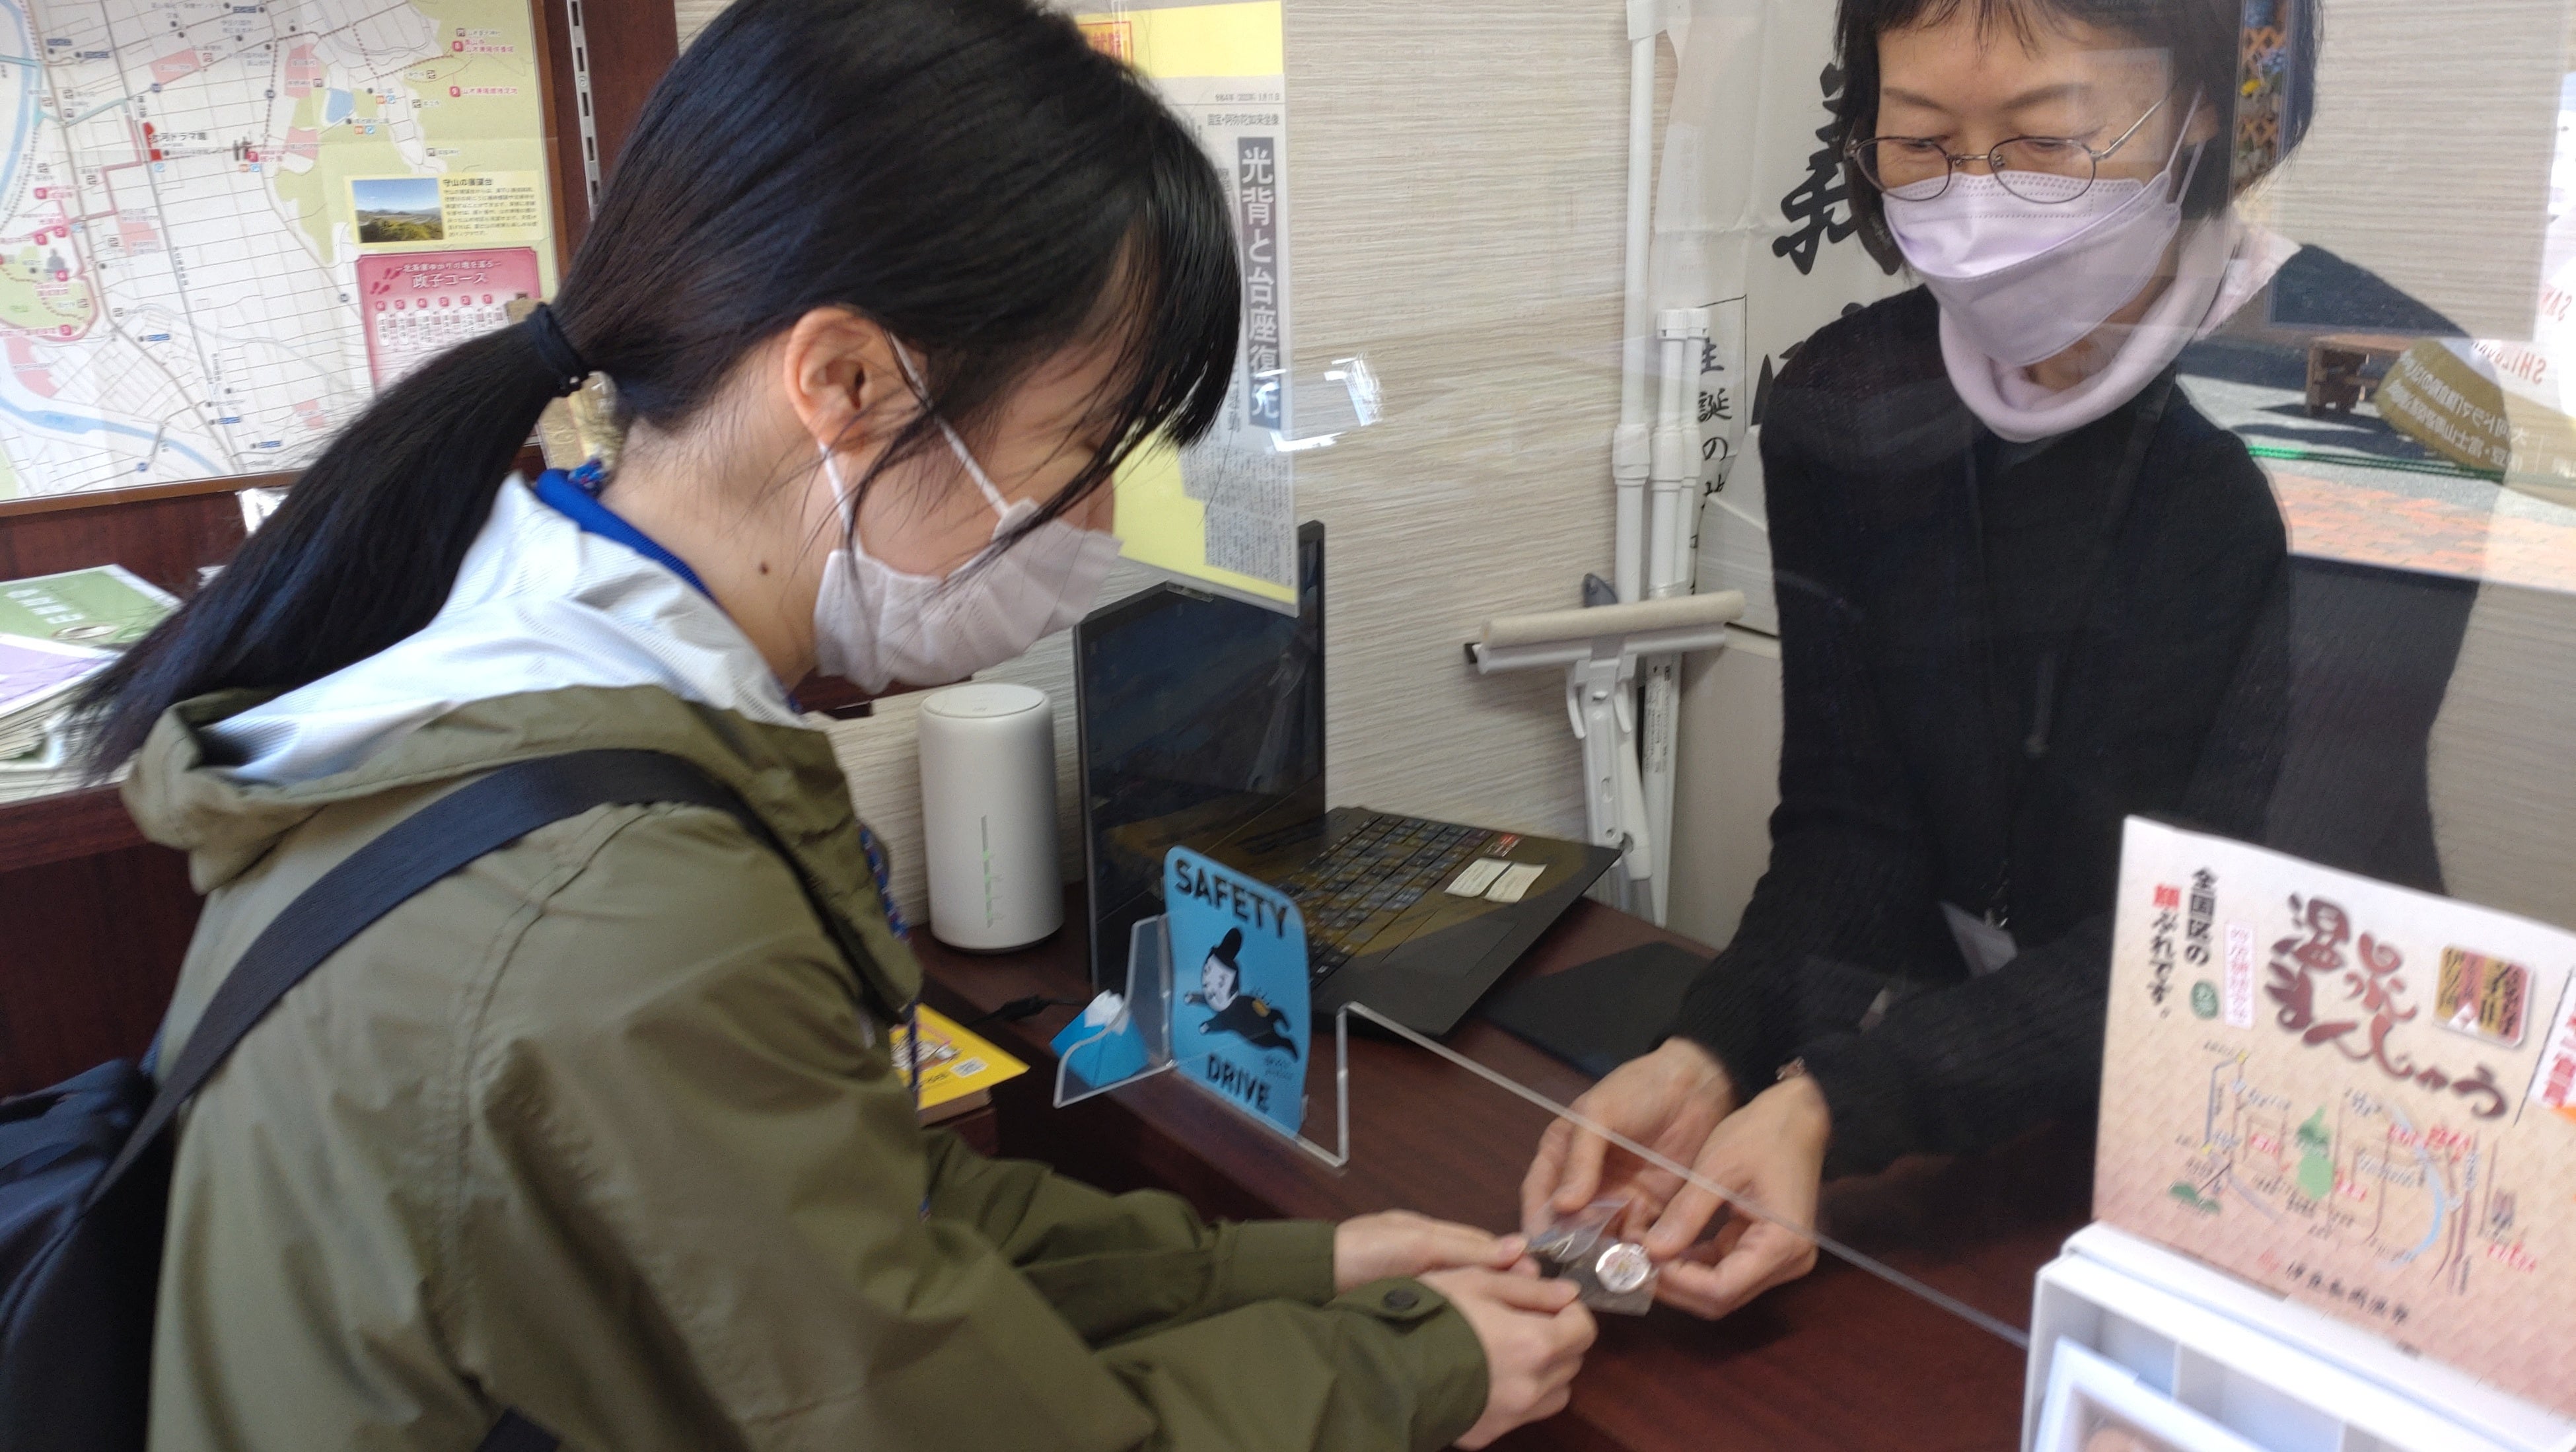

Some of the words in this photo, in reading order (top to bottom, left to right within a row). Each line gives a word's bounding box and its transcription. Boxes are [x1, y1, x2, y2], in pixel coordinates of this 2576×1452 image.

[412, 272, 489, 289] 政子コース
[1241, 147, 1281, 419] 光背と台座復元
[1172, 859, 1291, 939] SAFETY
[1206, 1053, 1272, 1114] DRIVE
